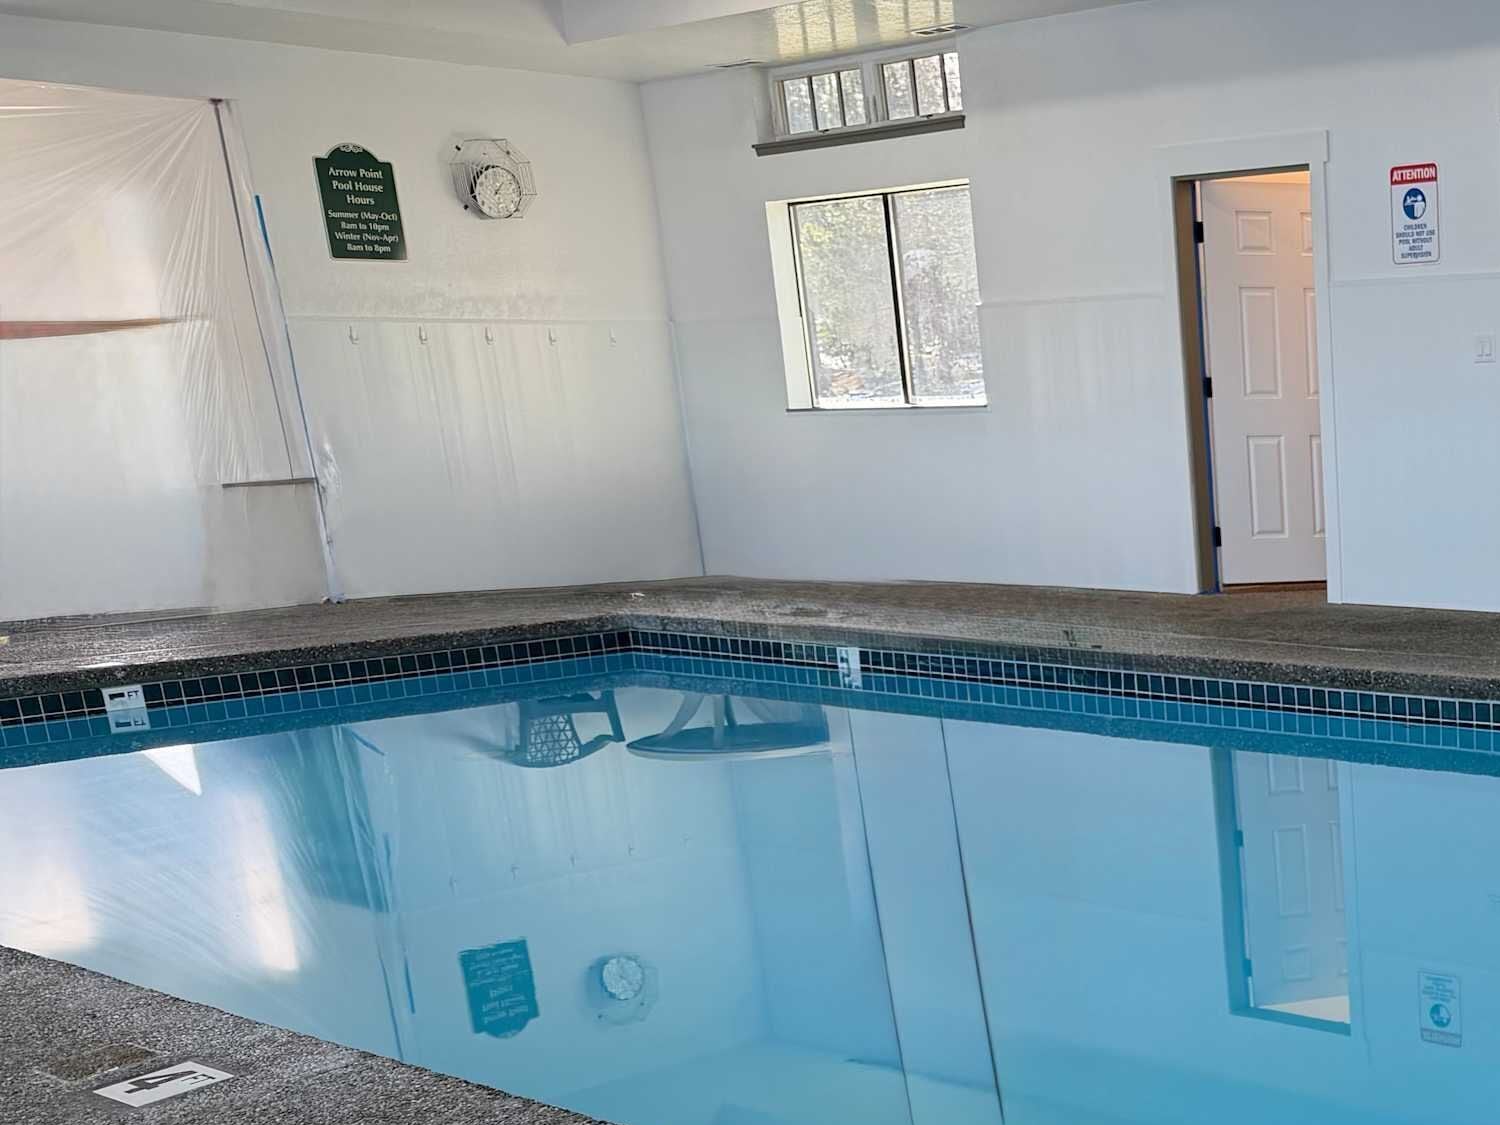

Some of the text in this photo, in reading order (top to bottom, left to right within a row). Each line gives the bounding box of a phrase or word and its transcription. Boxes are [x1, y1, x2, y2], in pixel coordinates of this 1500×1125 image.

[328, 167, 384, 179] Arrow Point
[1392, 168, 1436, 182] ATTENTION
[332, 180, 384, 192] Pool House
[346, 194, 375, 205] Hours
[328, 209, 398, 221] Summer (May-Oct)
[340, 221, 390, 232] 8am to 10pm
[335, 231, 399, 243] Winter (Nov-Apr)
[346, 243, 391, 254] 8am to 8pm
[124, 1070, 217, 1094] 4 FT
